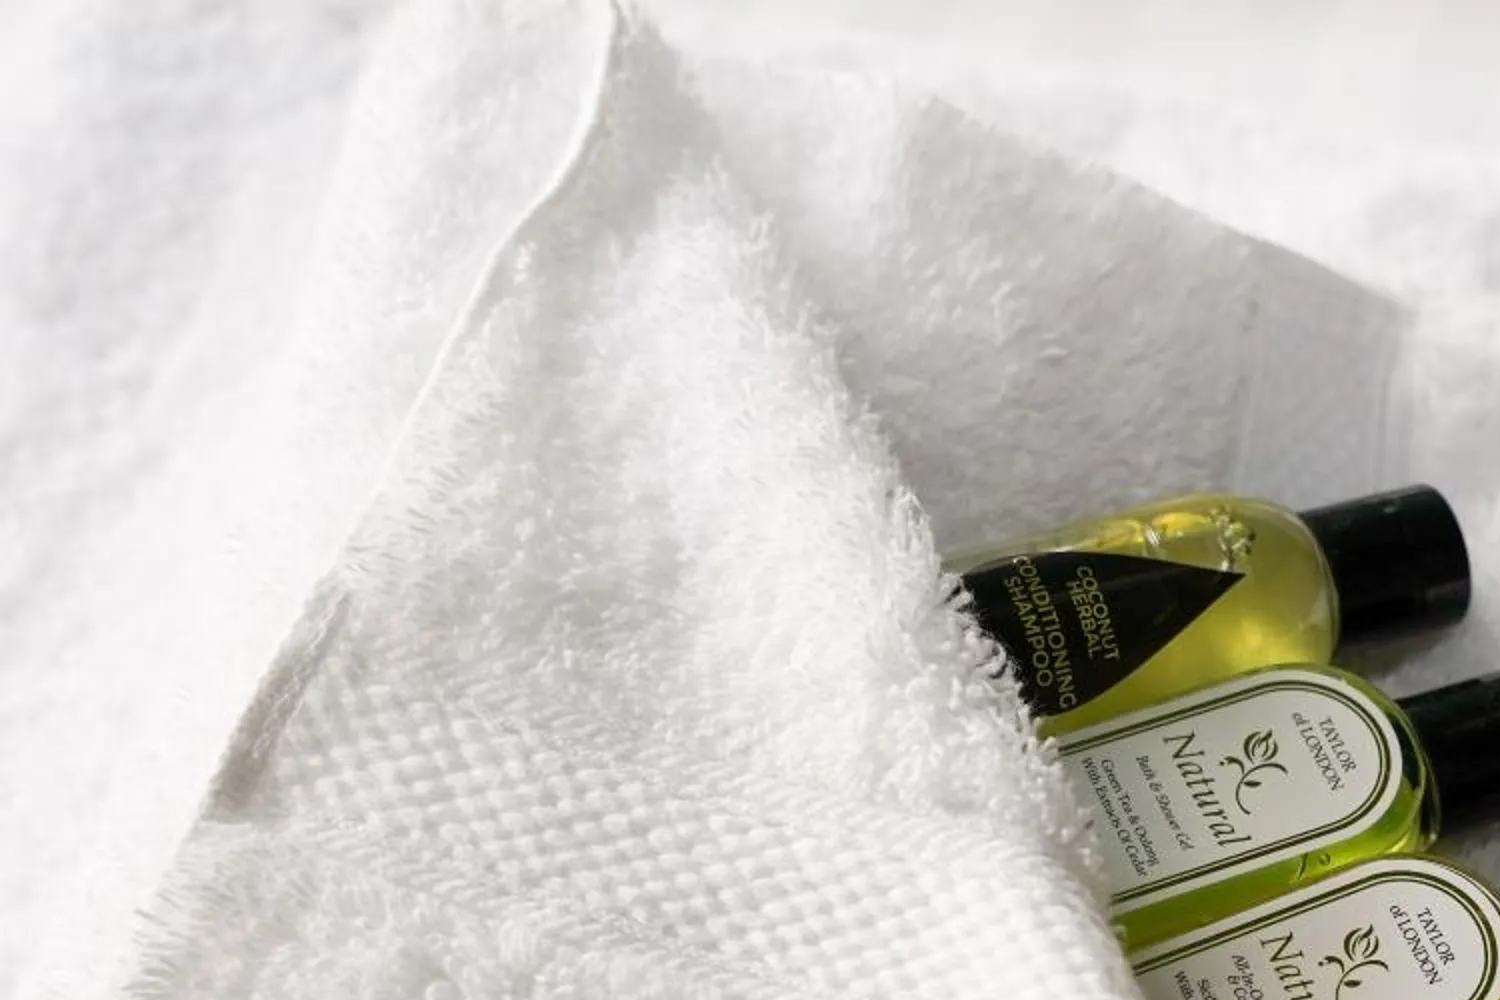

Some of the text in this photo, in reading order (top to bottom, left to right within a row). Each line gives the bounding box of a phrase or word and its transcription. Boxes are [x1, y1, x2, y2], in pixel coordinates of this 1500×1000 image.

[1002, 575, 1054, 688] SHAMPOO
[1010, 553, 1077, 710] CONDITIONING
[1066, 579, 1102, 658] HERBAL
[1075, 564, 1121, 660] COCONUT
[1290, 710, 1344, 792] of LONDON
[1318, 716, 1357, 774] TAYLOR
[1161, 728, 1252, 849] Natural
[1388, 904, 1443, 986] of LONDON
[1416, 906, 1456, 966] TAYLOR
[1172, 970, 1196, 1000] With
